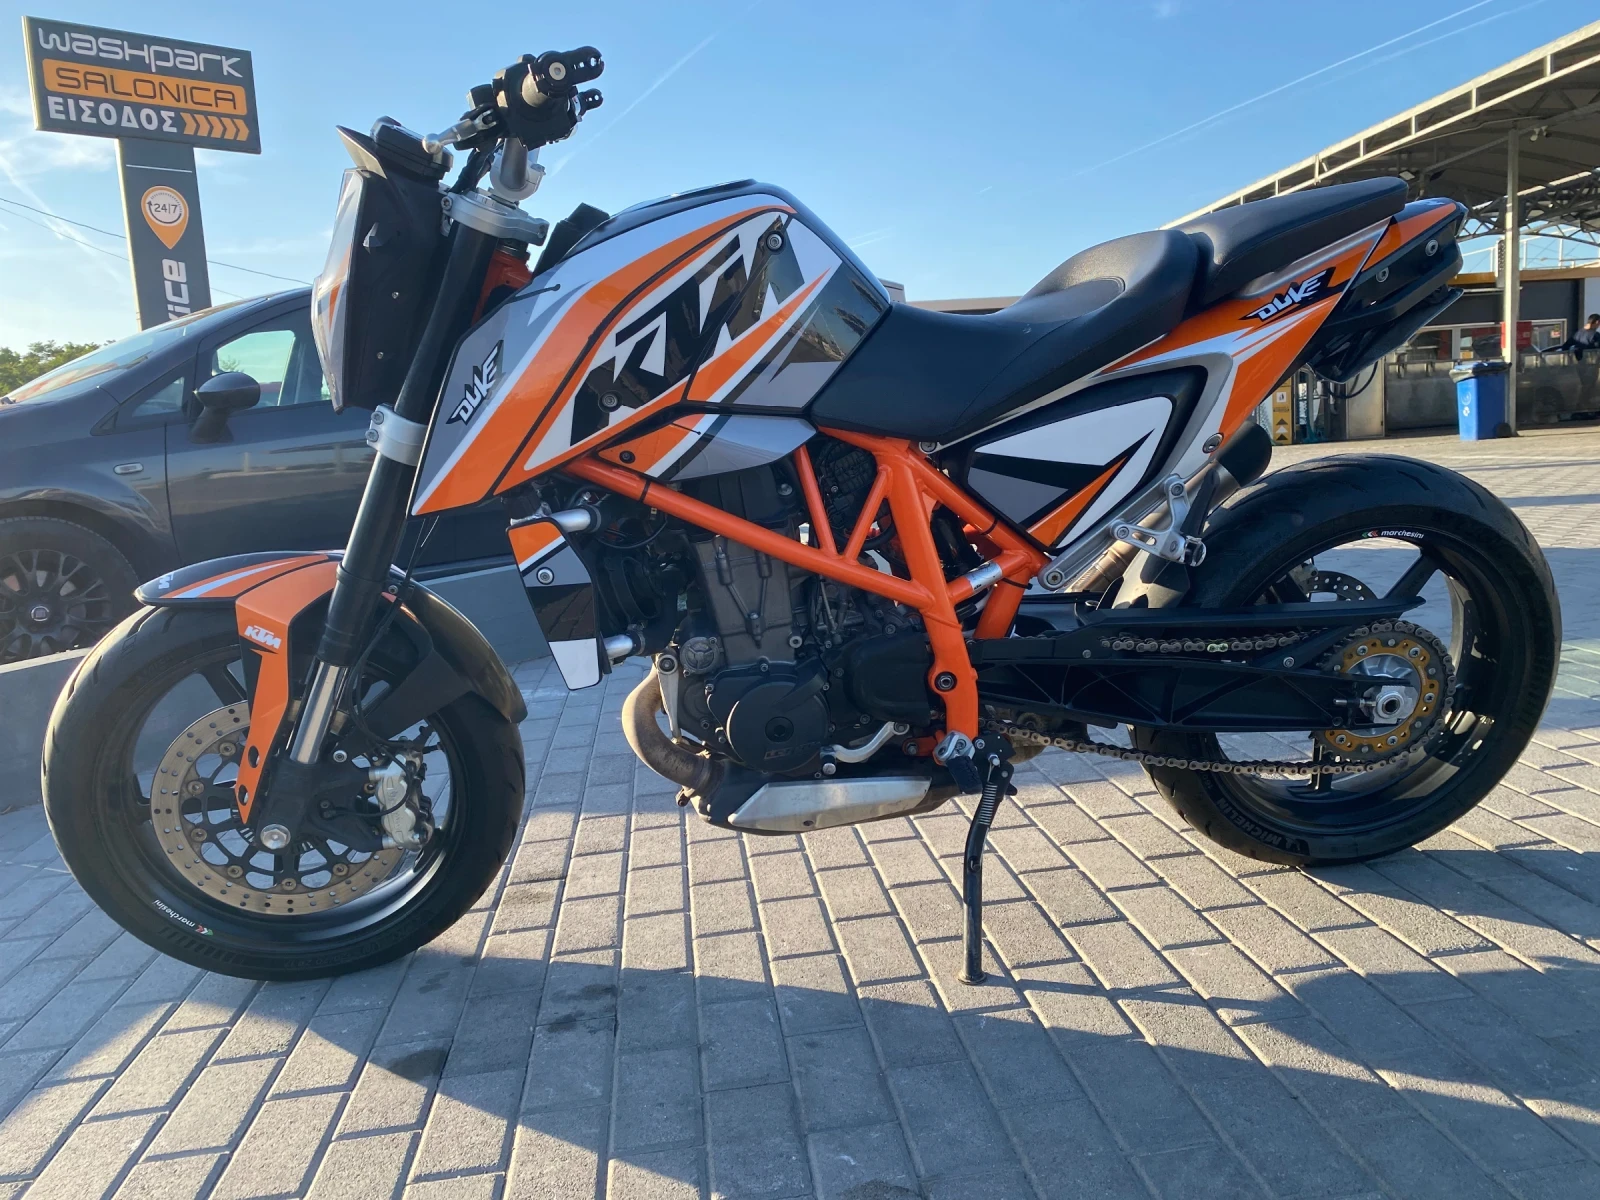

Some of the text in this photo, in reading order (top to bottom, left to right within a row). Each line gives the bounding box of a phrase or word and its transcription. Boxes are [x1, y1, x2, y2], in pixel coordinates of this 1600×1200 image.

[55, 67, 237, 110] SALONICA
[47, 96, 178, 133] ΕΙΣΟΔΟΣ
[1245, 269, 1327, 321] DUKE
[449, 344, 500, 424] DUKE
[1380, 529, 1424, 540] marchesini
[244, 625, 282, 650] KTM
[1216, 797, 1282, 846] MICHELIN
[153, 899, 196, 928] marchesini
